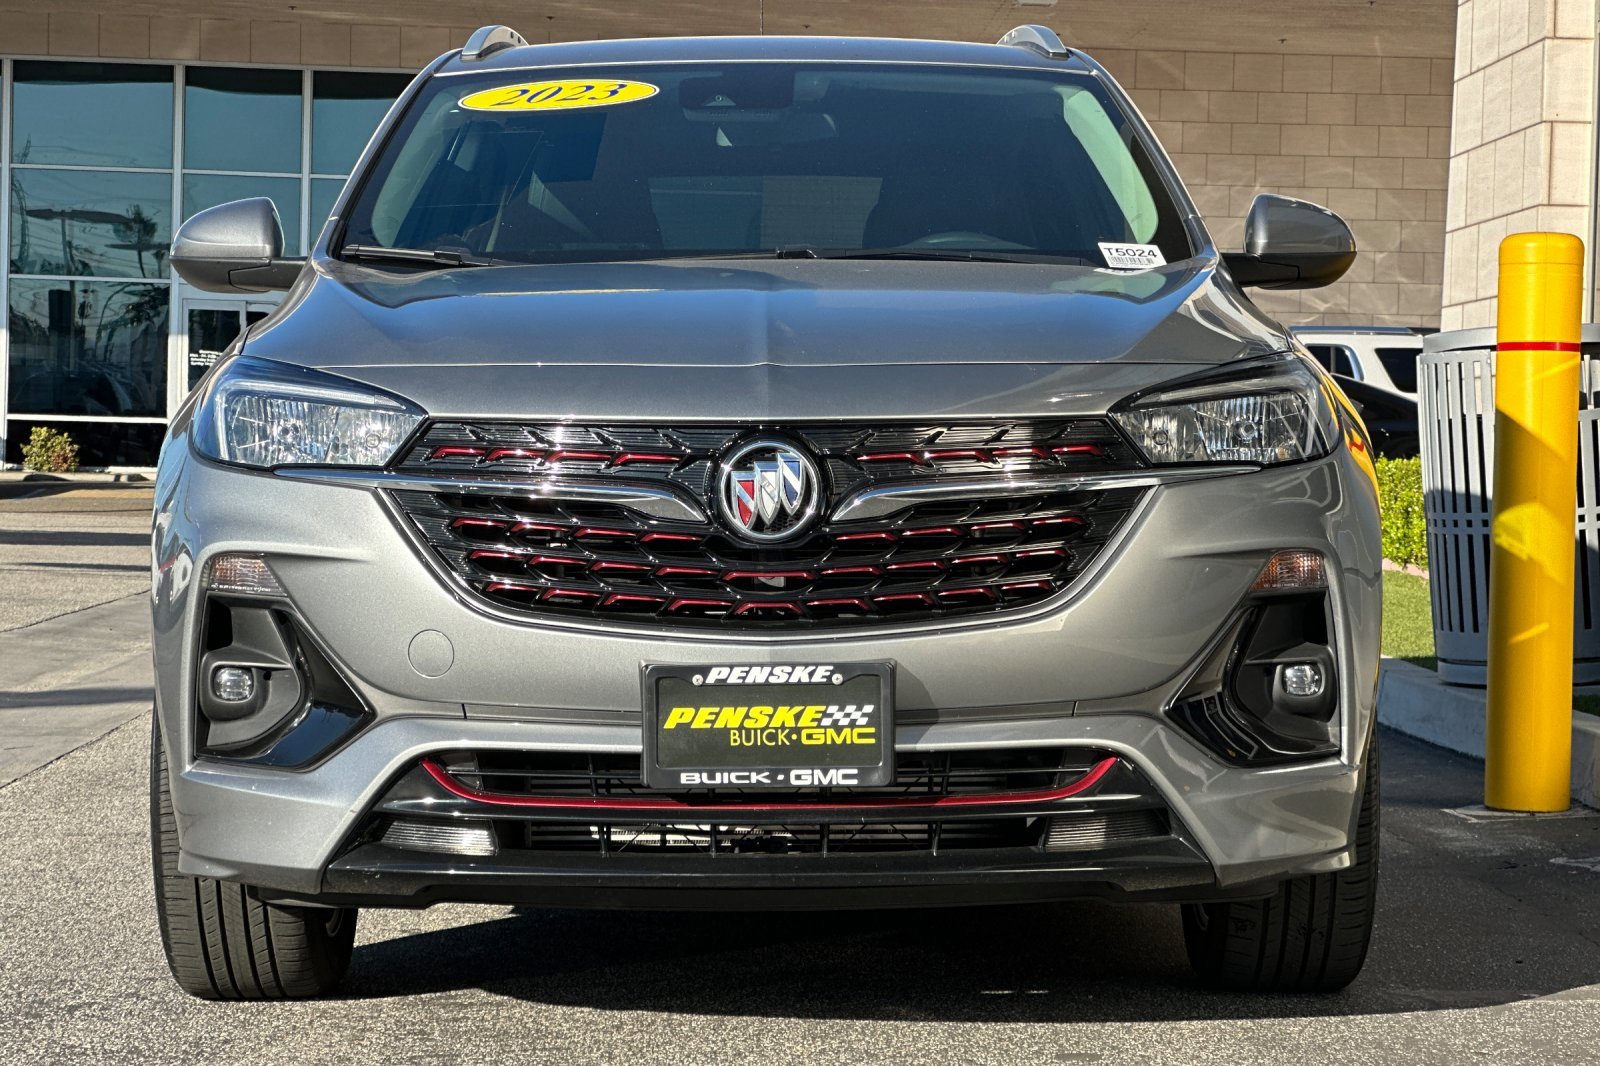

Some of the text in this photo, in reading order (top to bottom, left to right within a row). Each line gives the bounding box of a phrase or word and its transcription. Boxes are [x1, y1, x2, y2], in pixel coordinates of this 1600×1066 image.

[489, 83, 628, 107] 2023
[1103, 247, 1158, 258] T5024
[705, 665, 834, 685] PENSKE
[663, 705, 826, 729] PENSKE
[729, 727, 876, 746] BUICK GMC
[680, 768, 858, 786] BUICK GMC
